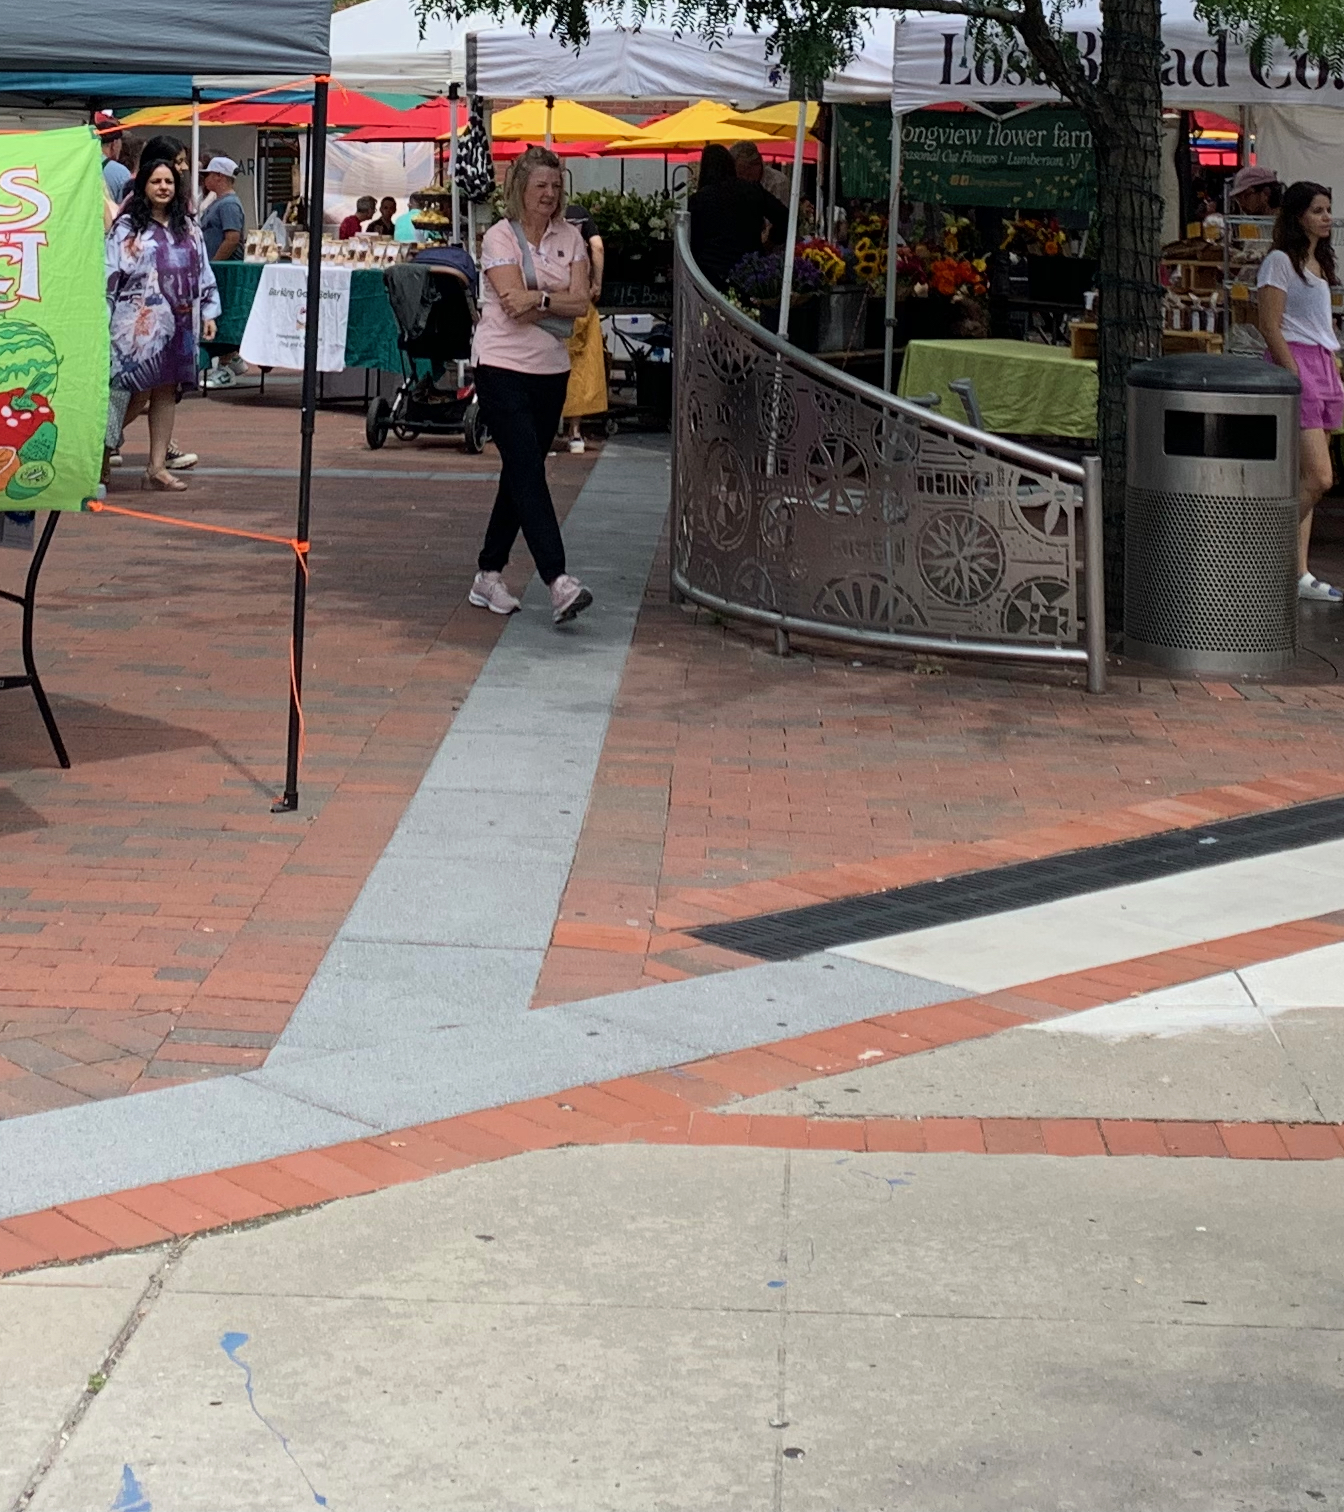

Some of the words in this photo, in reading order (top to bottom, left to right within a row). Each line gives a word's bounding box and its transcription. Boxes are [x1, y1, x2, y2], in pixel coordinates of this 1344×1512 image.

[939, 32, 1052, 87] Los
[887, 122, 982, 150] ongview
[986, 121, 1047, 148] flower
[901, 149, 941, 163] easonal
[960, 150, 998, 164] Flowers
